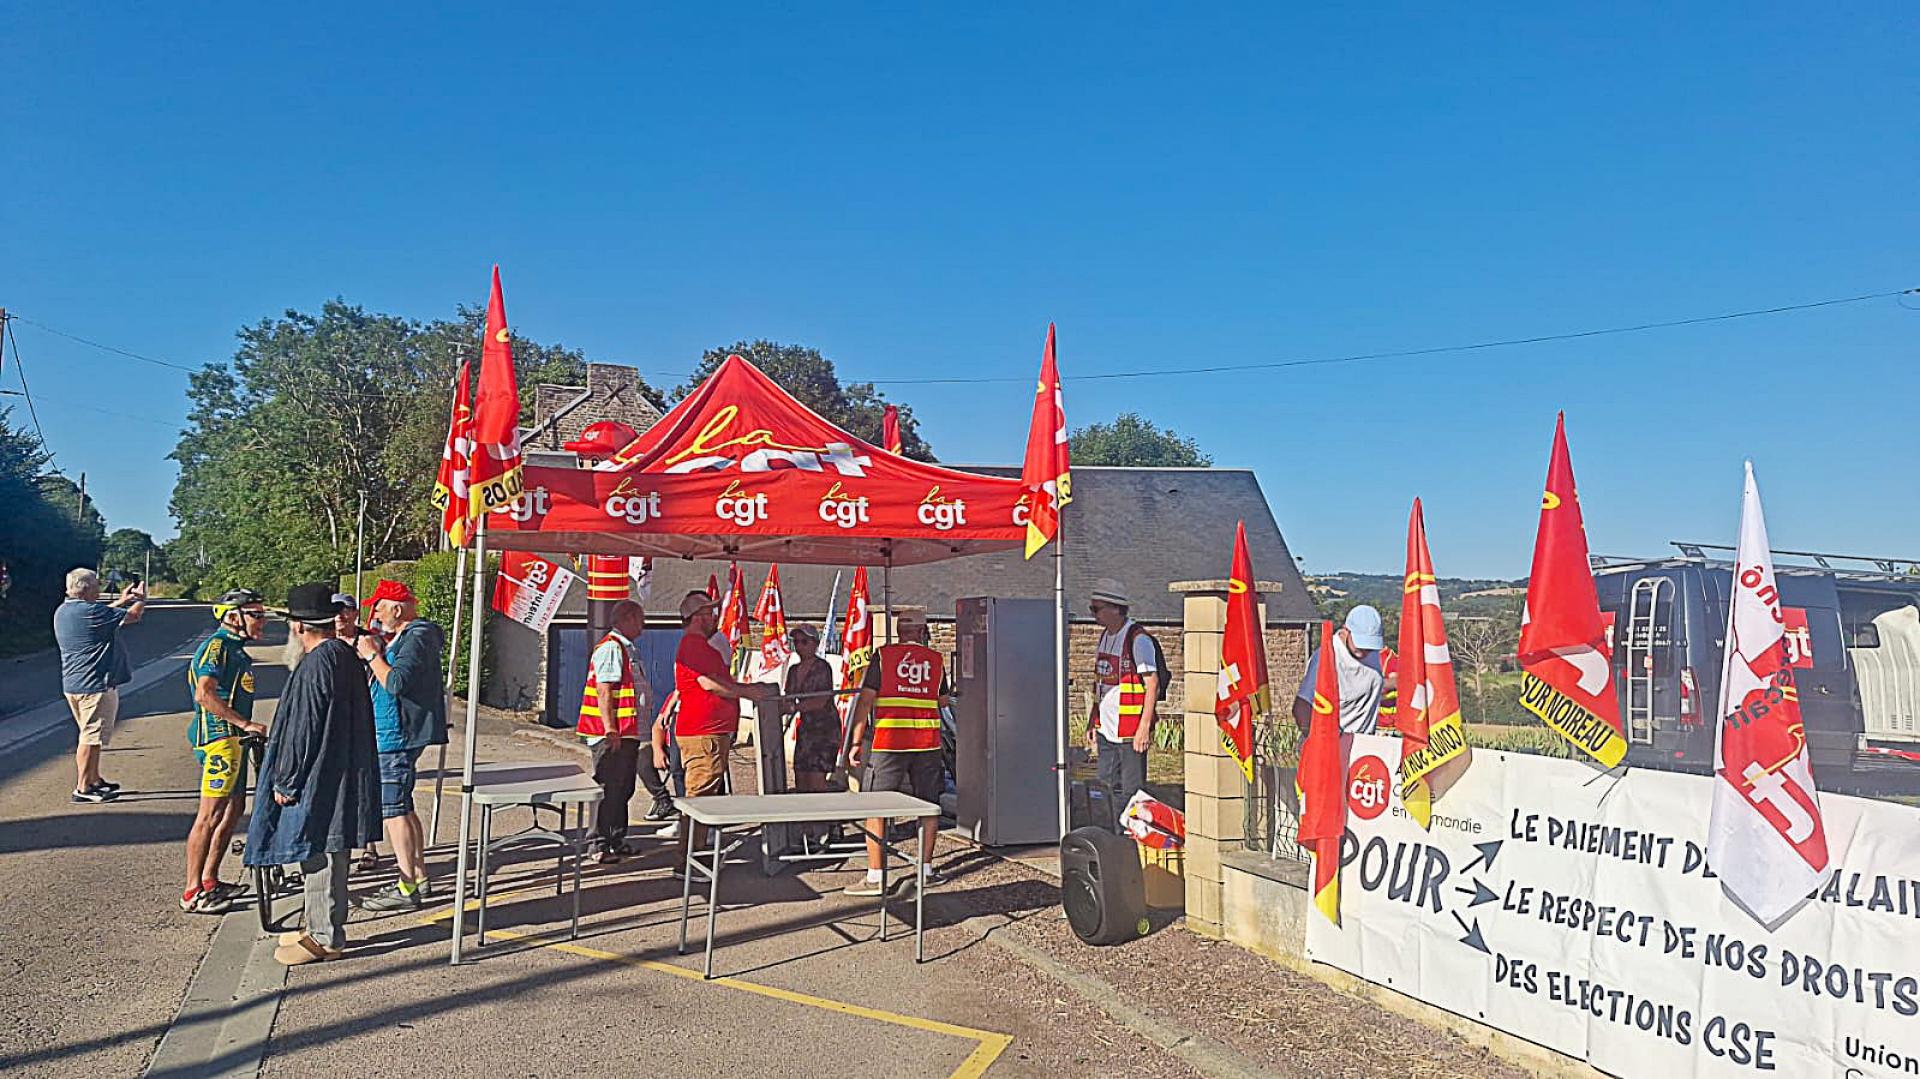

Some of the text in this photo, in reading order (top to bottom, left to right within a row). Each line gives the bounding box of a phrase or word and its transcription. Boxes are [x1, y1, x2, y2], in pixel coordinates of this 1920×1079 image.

[492, 485, 549, 521] gt
[605, 491, 662, 524] cgt
[715, 492, 769, 526] cgt
[818, 496, 870, 528] cgt
[917, 498, 967, 530] cgt
[1783, 628, 1812, 664] gt
[896, 660, 932, 685] cgt
[1520, 673, 1615, 752] SUR NOIREAU
[1350, 778, 1386, 809] cgt
[1411, 811, 1482, 834] mandie
[1339, 826, 1450, 914] POUR
[1511, 808, 1539, 842] LE
[1547, 815, 1675, 869] PAIEMENT
[1806, 868, 1920, 919] ALAI
[1503, 879, 1919, 1017] LE RESPECT DE NOS DROITS
[1495, 952, 1776, 1071] DES ELECTIONS CSE
[1845, 1035, 1919, 1076] Union
